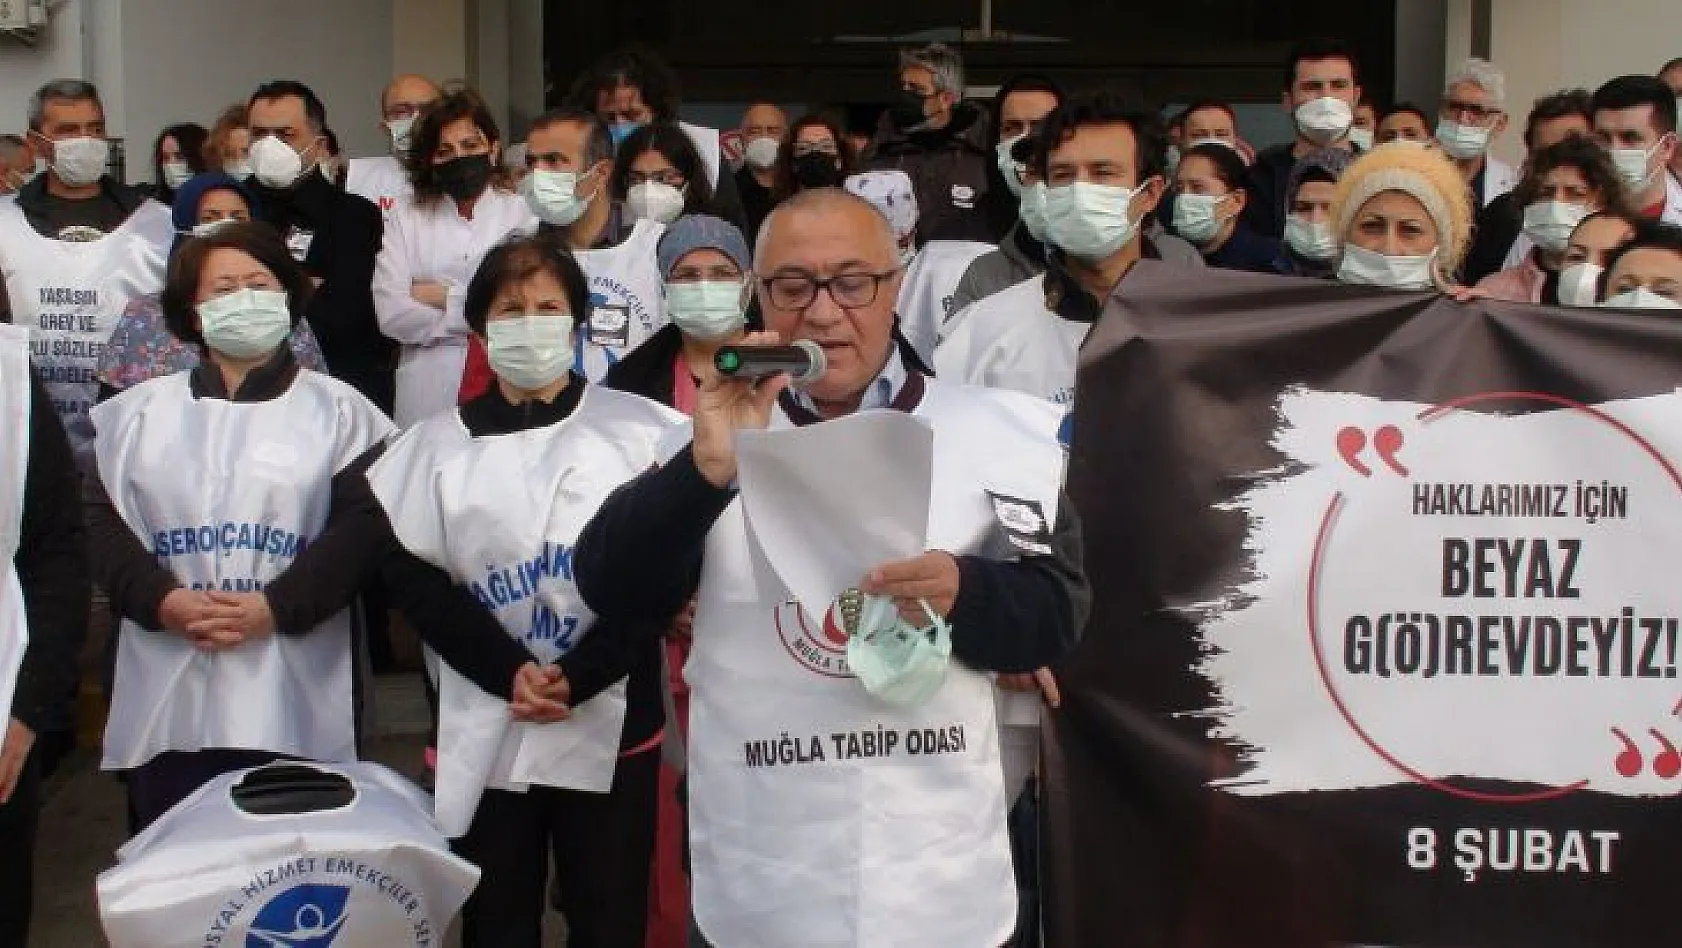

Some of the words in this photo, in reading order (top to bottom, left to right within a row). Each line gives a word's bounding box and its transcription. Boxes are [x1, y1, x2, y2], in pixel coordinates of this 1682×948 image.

[1412, 483, 1568, 518] HAKLARIMIZ
[1574, 479, 1627, 524] İÇİN
[1442, 538, 1582, 599] BEYAZ
[1343, 606, 1678, 679] G(Ö)REVDEYİZ!
[744, 731, 826, 768] MUĞLA
[831, 723, 899, 760] TABİP
[904, 725, 967, 756] ODASI
[1406, 827, 1438, 870] 8
[1454, 828, 1621, 882] ŞUBAT
